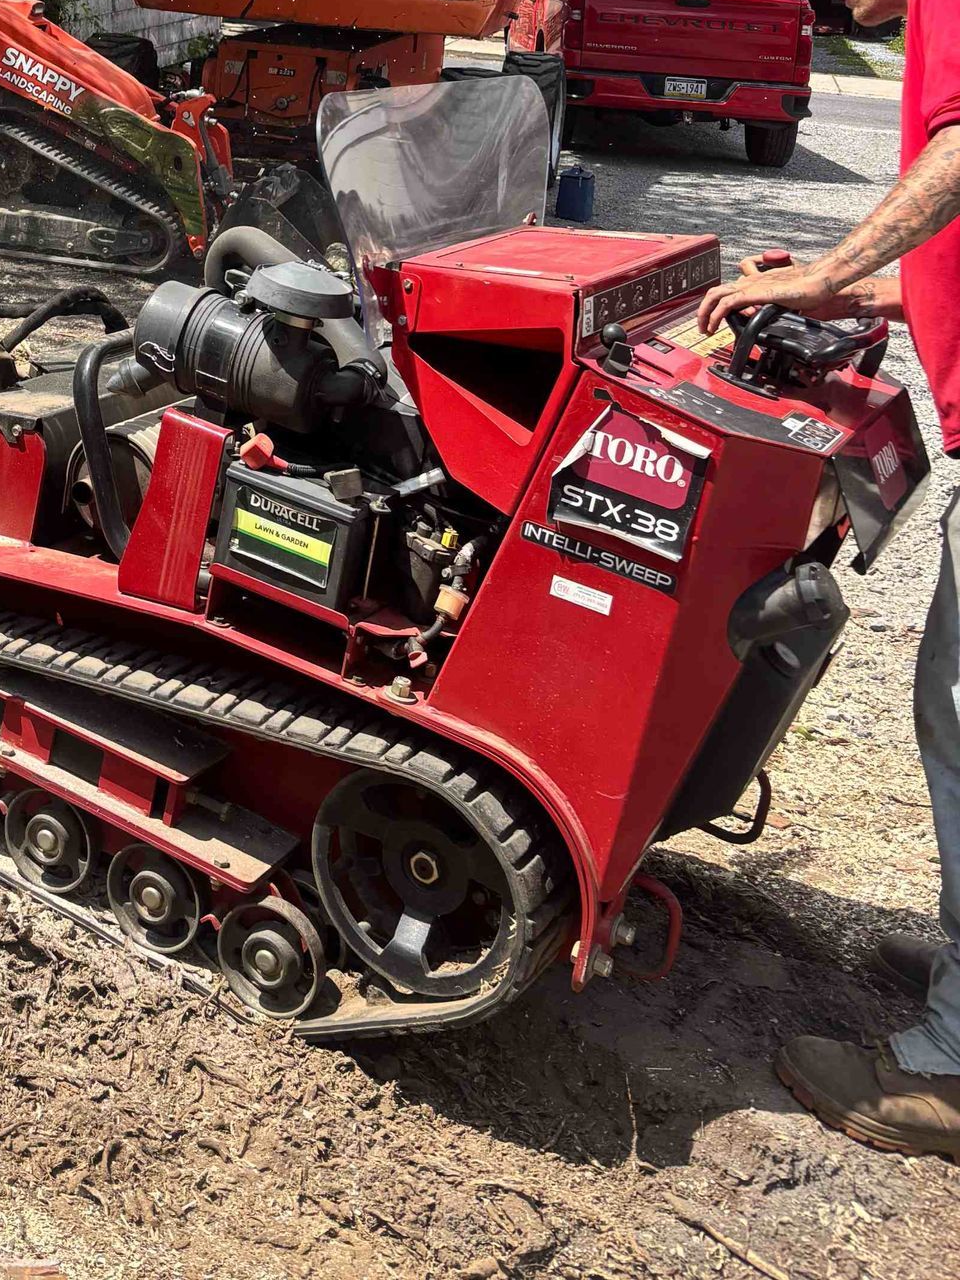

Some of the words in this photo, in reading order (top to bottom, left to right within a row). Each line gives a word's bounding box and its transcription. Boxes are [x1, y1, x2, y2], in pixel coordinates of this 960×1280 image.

[598, 12, 781, 33] CHEVROLET
[586, 42, 637, 51] SILVERADO
[758, 54, 792, 62] CUSTOM
[1, 47, 85, 102] SNAPPY
[587, 429, 685, 484] TORO
[872, 440, 899, 484] TORO
[250, 493, 320, 531] DURACELL
[254, 522, 274, 536] LAWN
[275, 530, 280, 538] &
[281, 533, 309, 549] GARDEN
[524, 522, 672, 586] INTELLI-SWEEP
